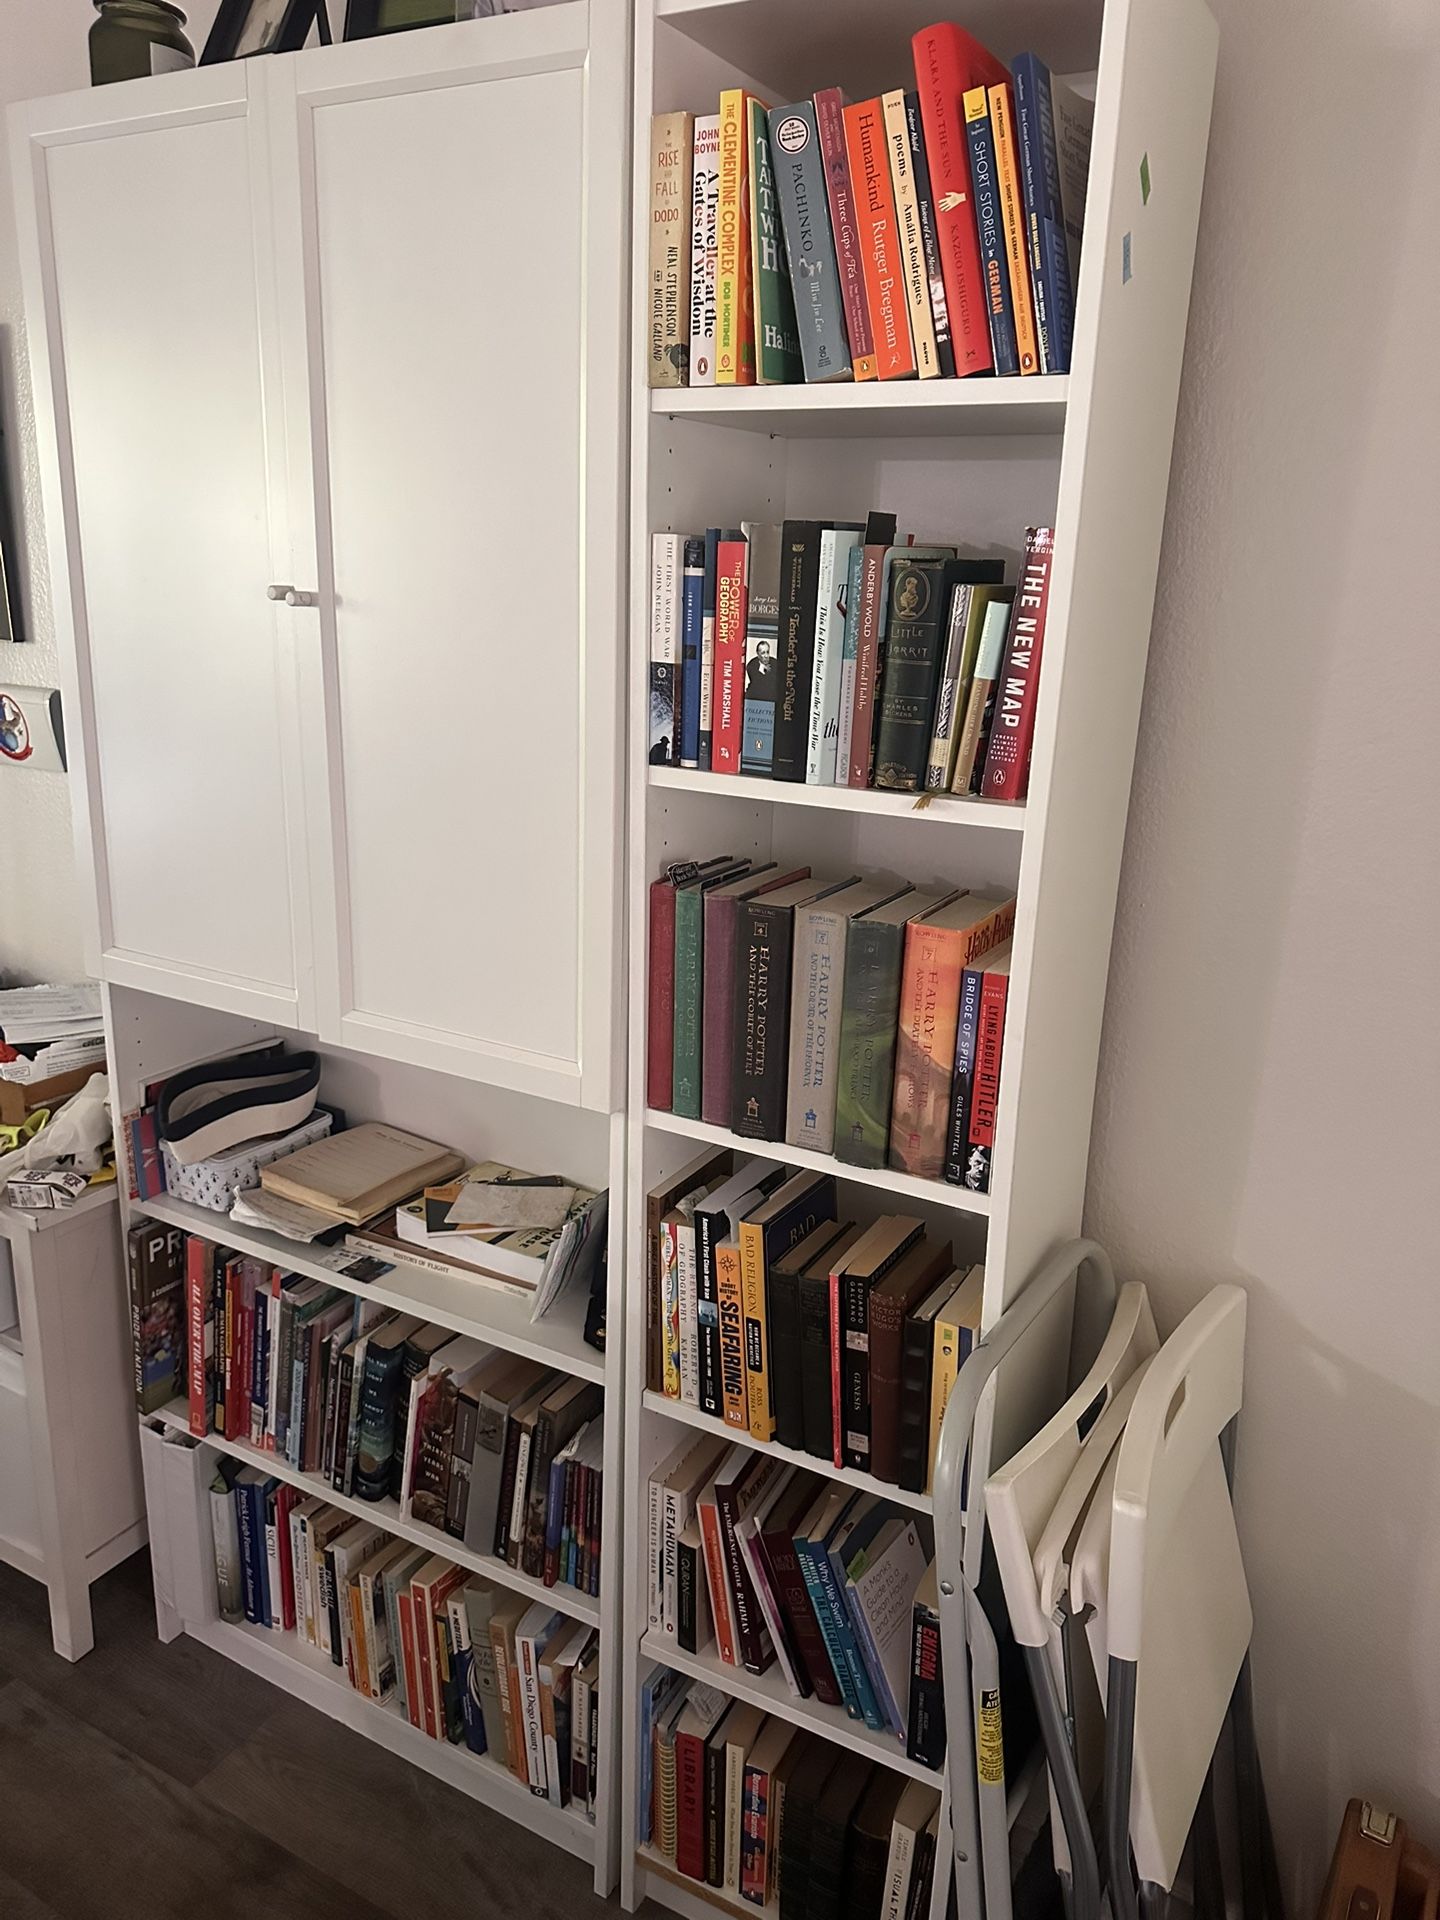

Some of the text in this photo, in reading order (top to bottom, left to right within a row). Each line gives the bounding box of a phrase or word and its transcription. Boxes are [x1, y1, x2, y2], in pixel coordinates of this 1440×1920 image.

[926, 39, 952, 179] KLARA AND THE SUN
[694, 142, 720, 154] BOYNE
[696, 128, 720, 141] JOHN
[658, 150, 679, 168] RISE
[974, 141, 991, 187] SHORT
[655, 182, 678, 196] FALL
[721, 103, 737, 275] THE CLEMENTINE COMPLEX
[792, 163, 813, 252] PACHINKO
[837, 190, 848, 222] Three
[654, 208, 679, 223] DODO
[859, 113, 897, 348] Humankind Rutger Bregman
[893, 134, 922, 305] poems by Rodrigues
[980, 192, 997, 247] STORIES
[692, 172, 706, 336] Gates of Wisdom
[704, 169, 720, 338] A Traveller at the
[988, 249, 994, 258] in
[951, 224, 971, 335] KAZUO ISHIGURO
[987, 260, 1004, 315] GERMAN
[666, 272, 677, 337] STEPHENSON
[722, 281, 731, 347] BOB MORTIMER
[716, 576, 731, 643] GEOGRAPHY
[727, 560, 742, 641] THE POWER OF
[856, 558, 876, 710] ANDERBY WOLD Winifred Holtby
[1002, 563, 1047, 729] THE NEW MAP
[782, 612, 801, 721] Tender Is the Night
[810, 605, 829, 750] This Is How You Lose the Time War
[719, 659, 733, 729] TIM MARSHALL
[748, 945, 757, 971] AND
[754, 945, 769, 1075] HARRY POTTER
[813, 954, 832, 1087] HARRY POTTER
[957, 977, 976, 1073] BRIDGE OF SPIES
[985, 1005, 999, 1034] LYING
[918, 971, 938, 1108] HARRY POTTER
[982, 1038, 995, 1070] ABOUT
[975, 1073, 996, 1127] HITLER
[951, 1095, 964, 1156] GILES WHITTELL
[702, 1245, 710, 1258] First
[789, 1214, 816, 1245] BAD
[393, 1251, 450, 1274] HISTORY OF FLIGHT
[703, 1259, 711, 1274] Clash
[745, 1235, 757, 1313] BAD RELIGION
[192, 1306, 201, 1338] OVER
[678, 1243, 687, 1379] OF GEOGRAPHY KAPLAN
[856, 1282, 864, 1323] EDUARDO
[871, 1304, 901, 1316] VICTOR
[132, 1304, 142, 1393] PRIDE NATION
[192, 1340, 201, 1364] THE
[689, 1333, 697, 1373] ROBERT
[720, 1300, 742, 1397] SEAFARING
[666, 1367, 674, 1378] Up
[853, 1372, 861, 1410] GENESIS
[755, 1387, 763, 1406] ROSS
[431, 1431, 443, 1442] THE
[423, 1456, 444, 1471] YEARS
[425, 1470, 440, 1482] WAR
[240, 1489, 251, 1562] Patrick Leigh Fermor
[265, 1528, 276, 1558] SICILY
[664, 1495, 675, 1576] METAHUMAN
[316, 1566, 328, 1608] swedish
[681, 1558, 690, 1593] QURAN
[722, 1501, 750, 1634] The EMERGENCE QATAR RAHMAN
[816, 1560, 832, 1584] Why
[814, 1594, 828, 1612] THE
[824, 1583, 837, 1600] We
[863, 1585, 869, 1596] A
[867, 1575, 894, 1609] Guide to
[871, 1597, 890, 1622] Clean
[829, 1600, 846, 1628] Swim
[875, 1614, 889, 1636] and
[820, 1614, 844, 1660] CALCULUS
[921, 1626, 937, 1681] ENIGMA
[525, 1676, 540, 1752] San Diego County
[681, 1748, 697, 1814] LIBRARY
[749, 1811, 759, 1838] Evaristo
